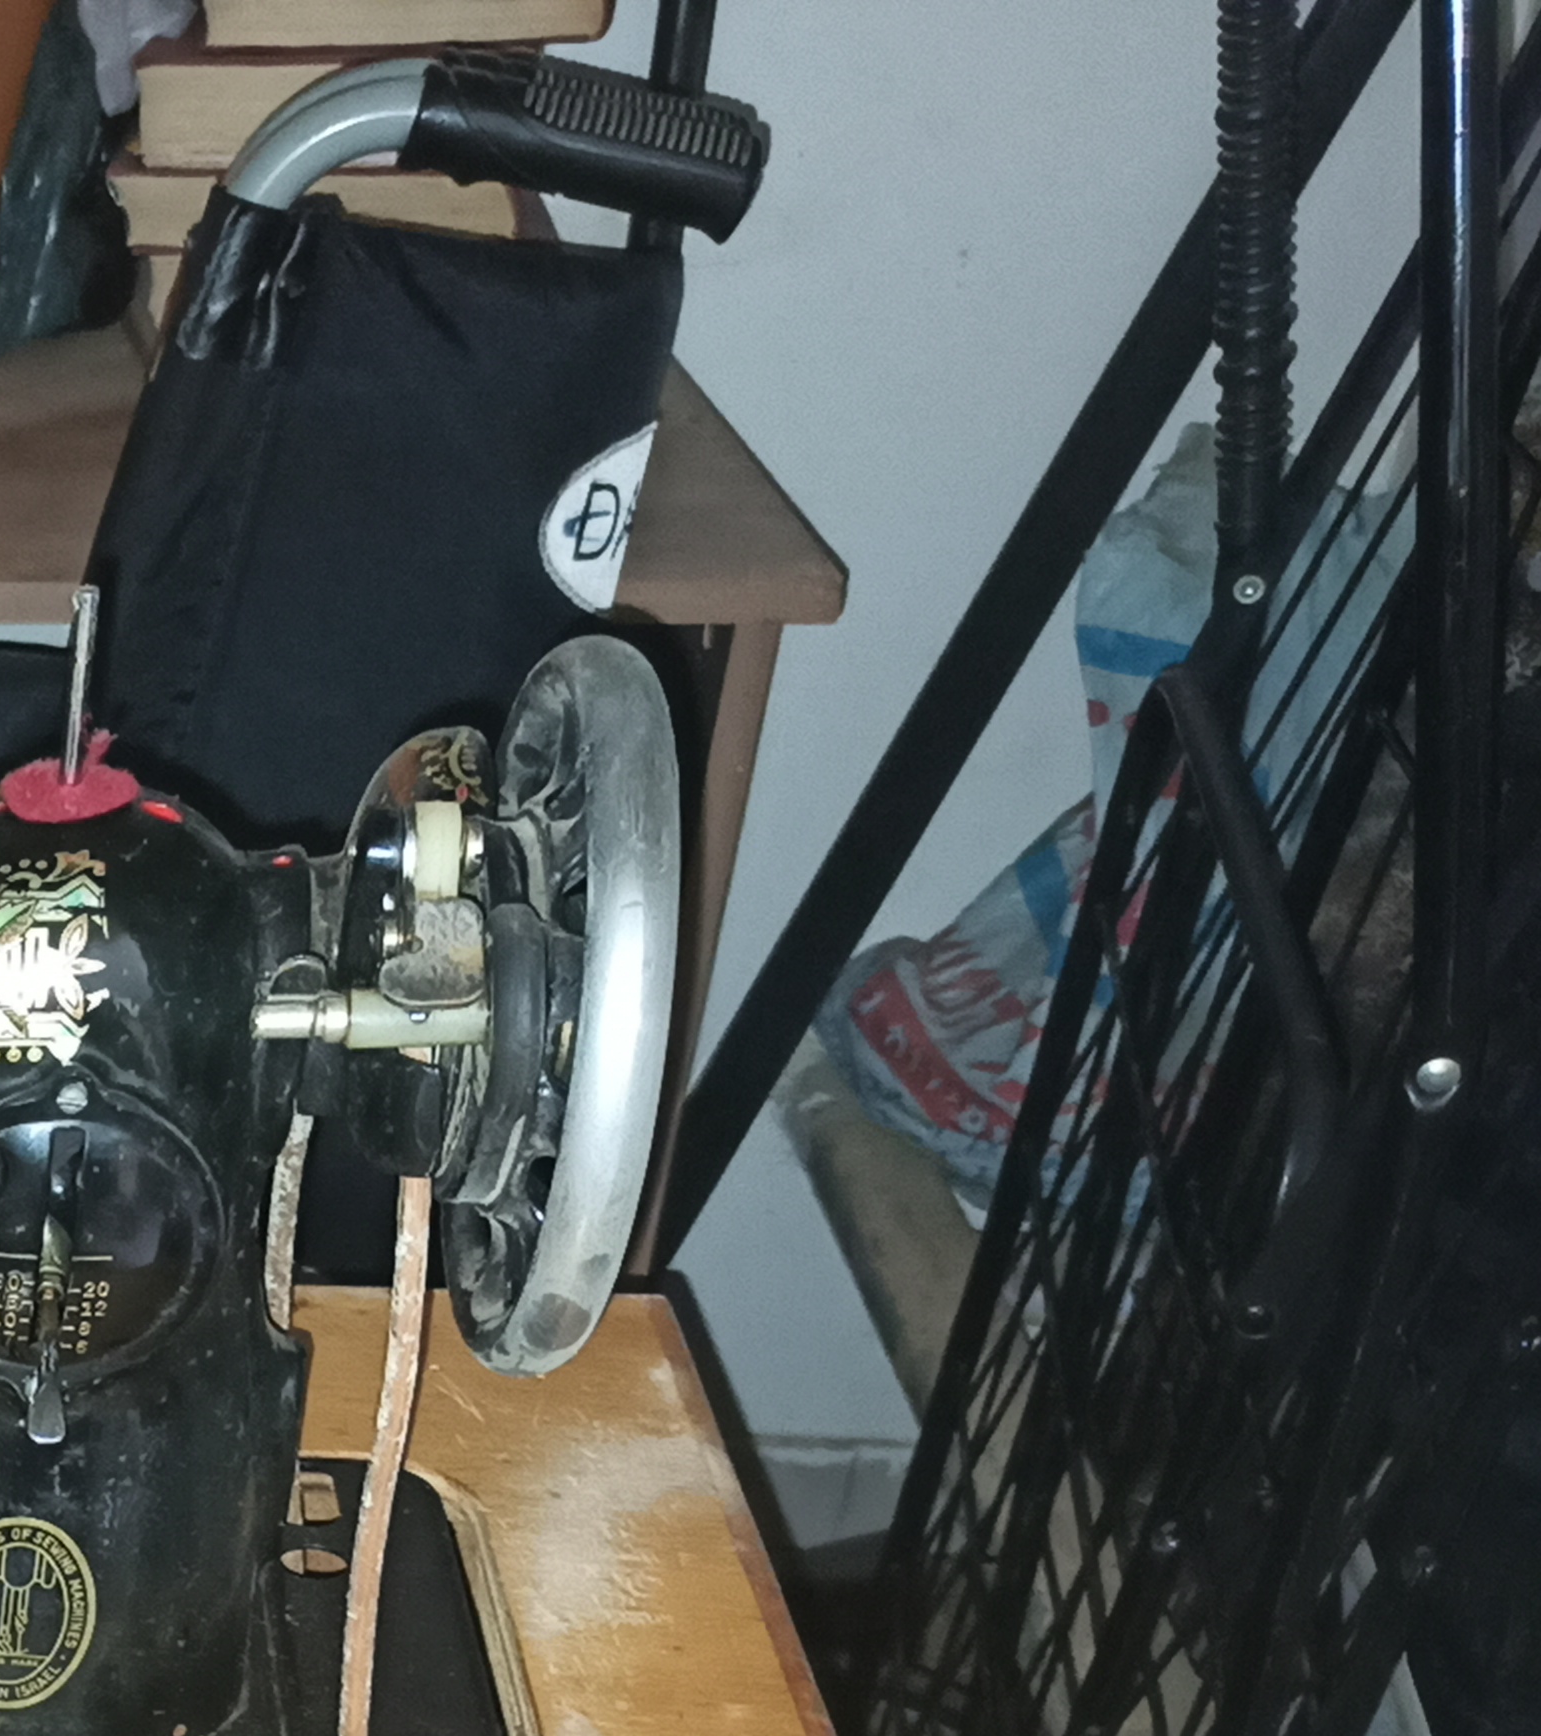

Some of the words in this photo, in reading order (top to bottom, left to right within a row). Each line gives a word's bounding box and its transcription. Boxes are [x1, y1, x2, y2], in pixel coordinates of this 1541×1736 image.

[82, 1280, 111, 1299] 20
[79, 1300, 109, 1318] 12
[10, 1527, 33, 1541] OF
[32, 1531, 78, 1576] SEWING
[64, 1578, 87, 1649] MACHINES
[14, 1665, 62, 1698] ISRAEL
